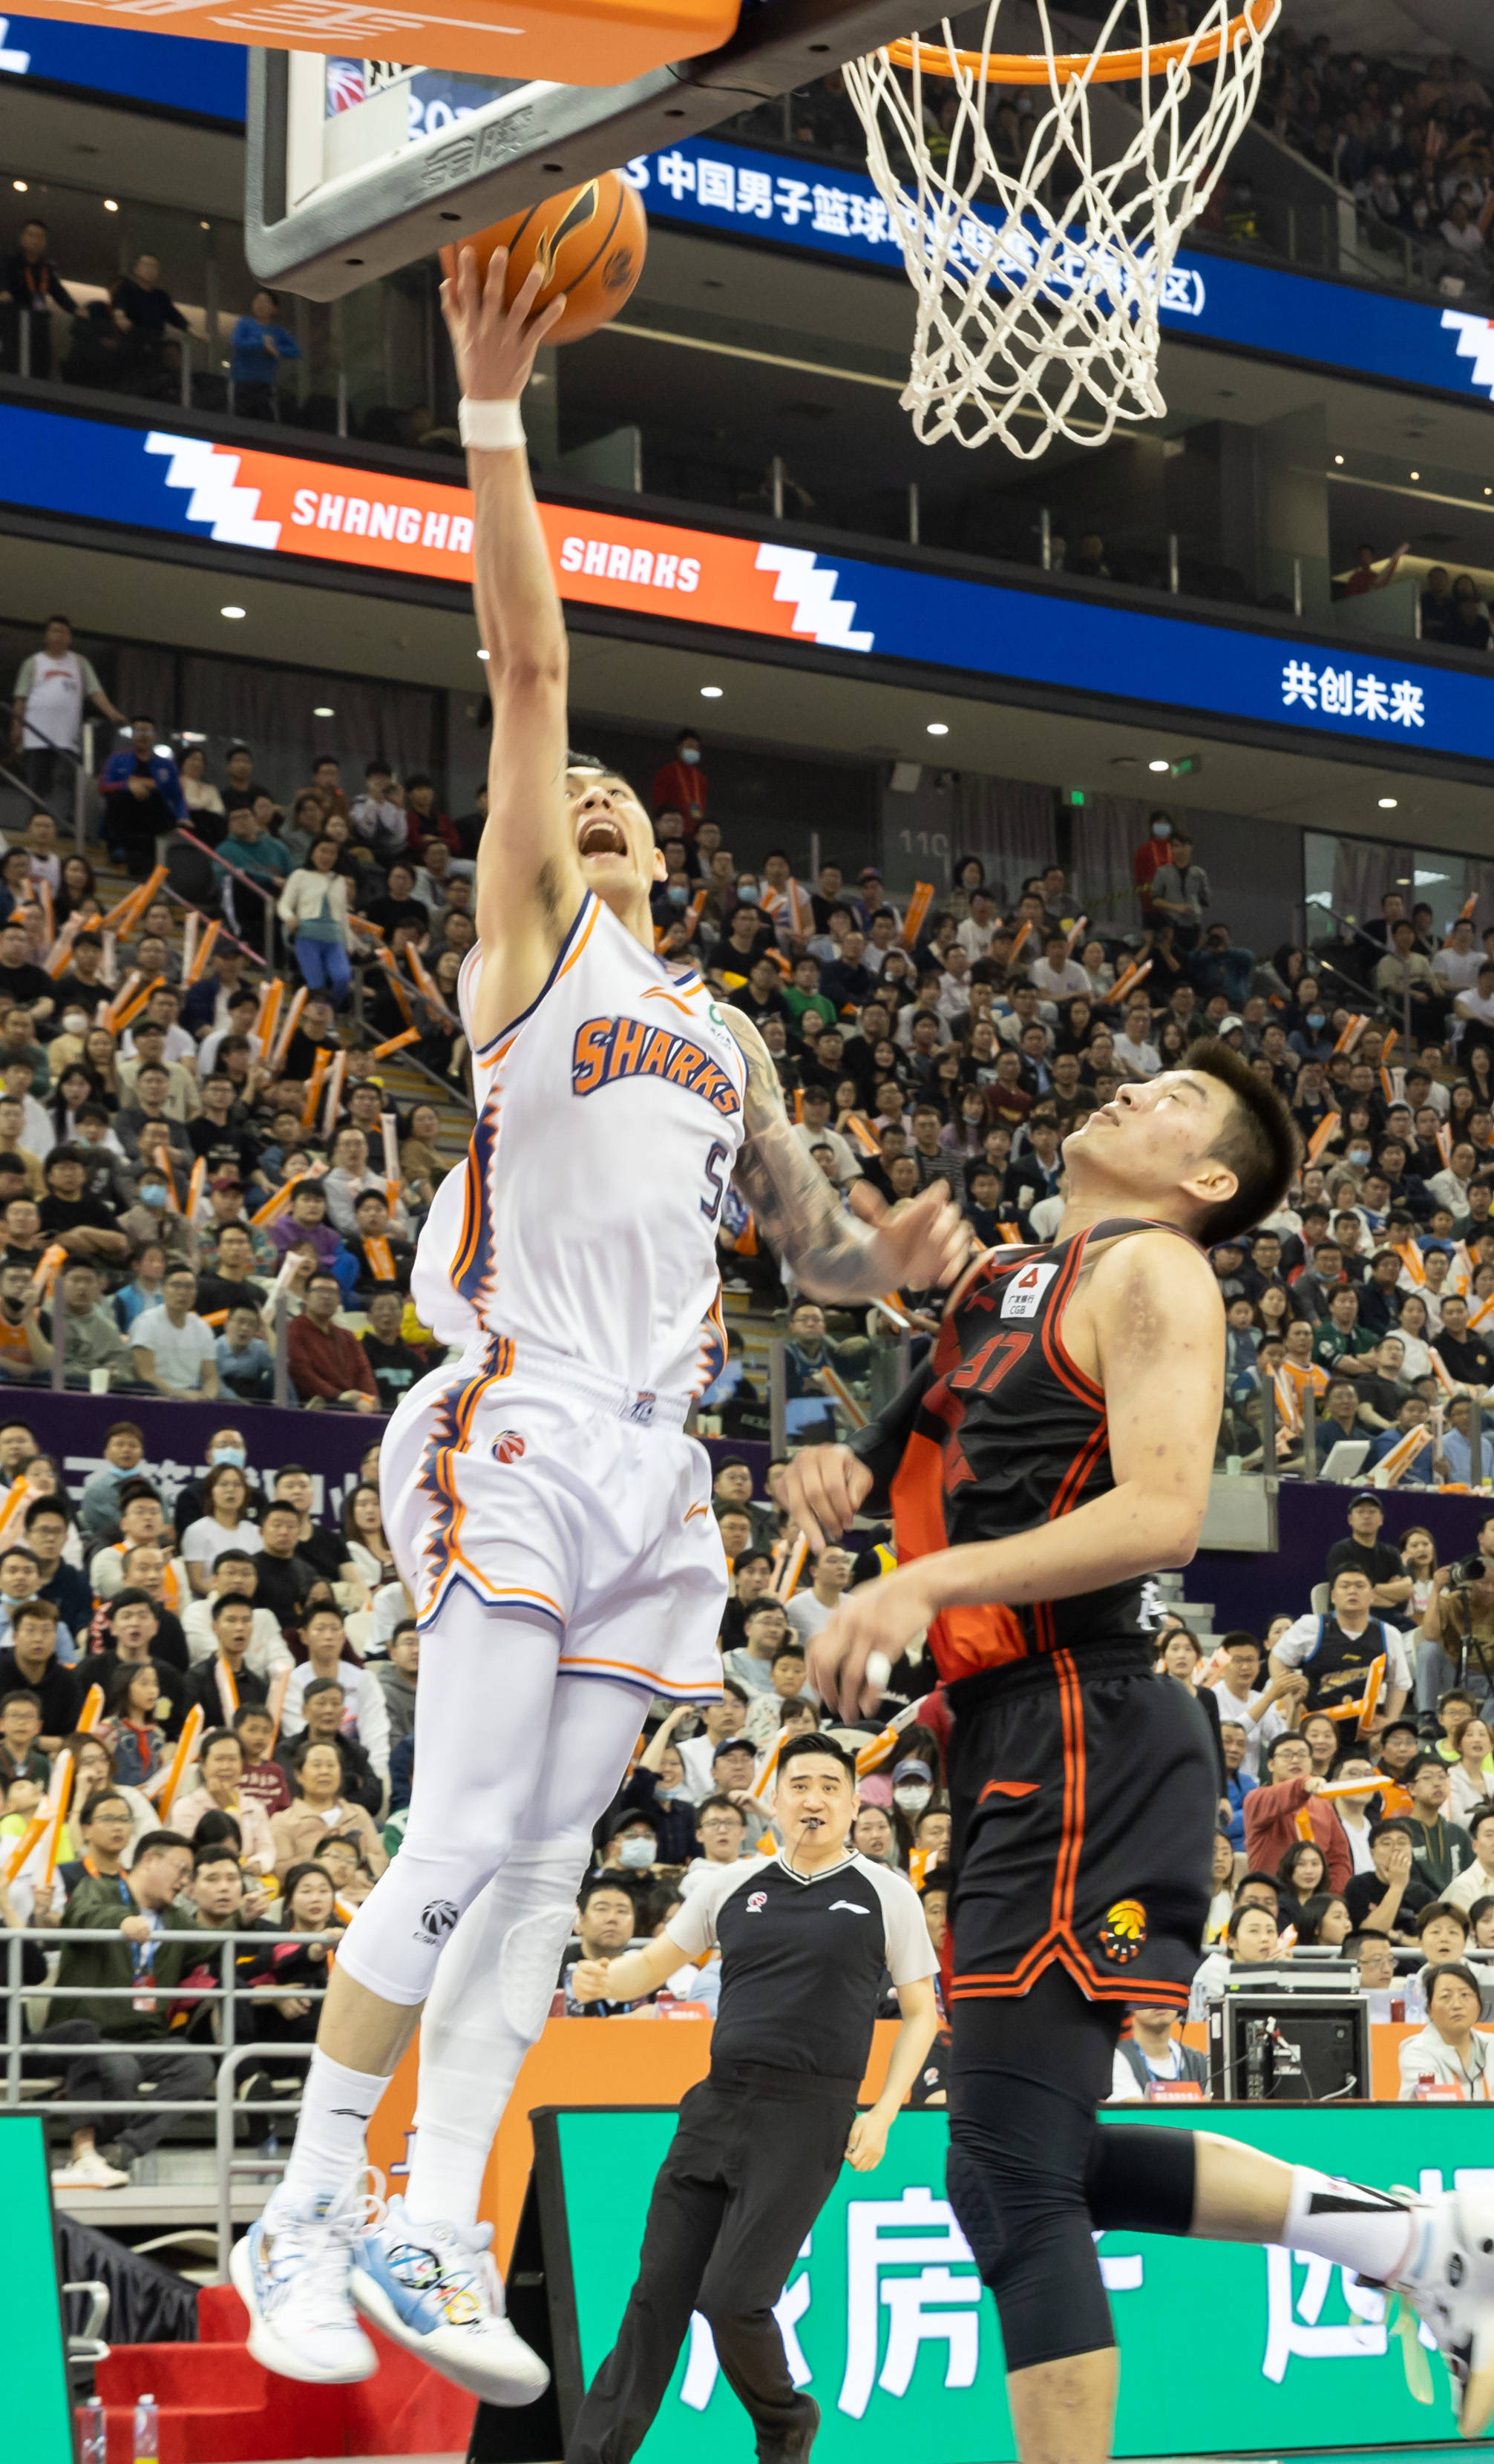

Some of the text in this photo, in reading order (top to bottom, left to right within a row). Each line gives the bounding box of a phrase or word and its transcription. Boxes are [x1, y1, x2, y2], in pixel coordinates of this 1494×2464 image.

[290, 489, 701, 593] SHANGHA SHARKS
[1281, 660, 1426, 728] 共创未来
[571, 1016, 741, 1117] SHARKS
[1009, 1305, 1026, 1315] CGB
